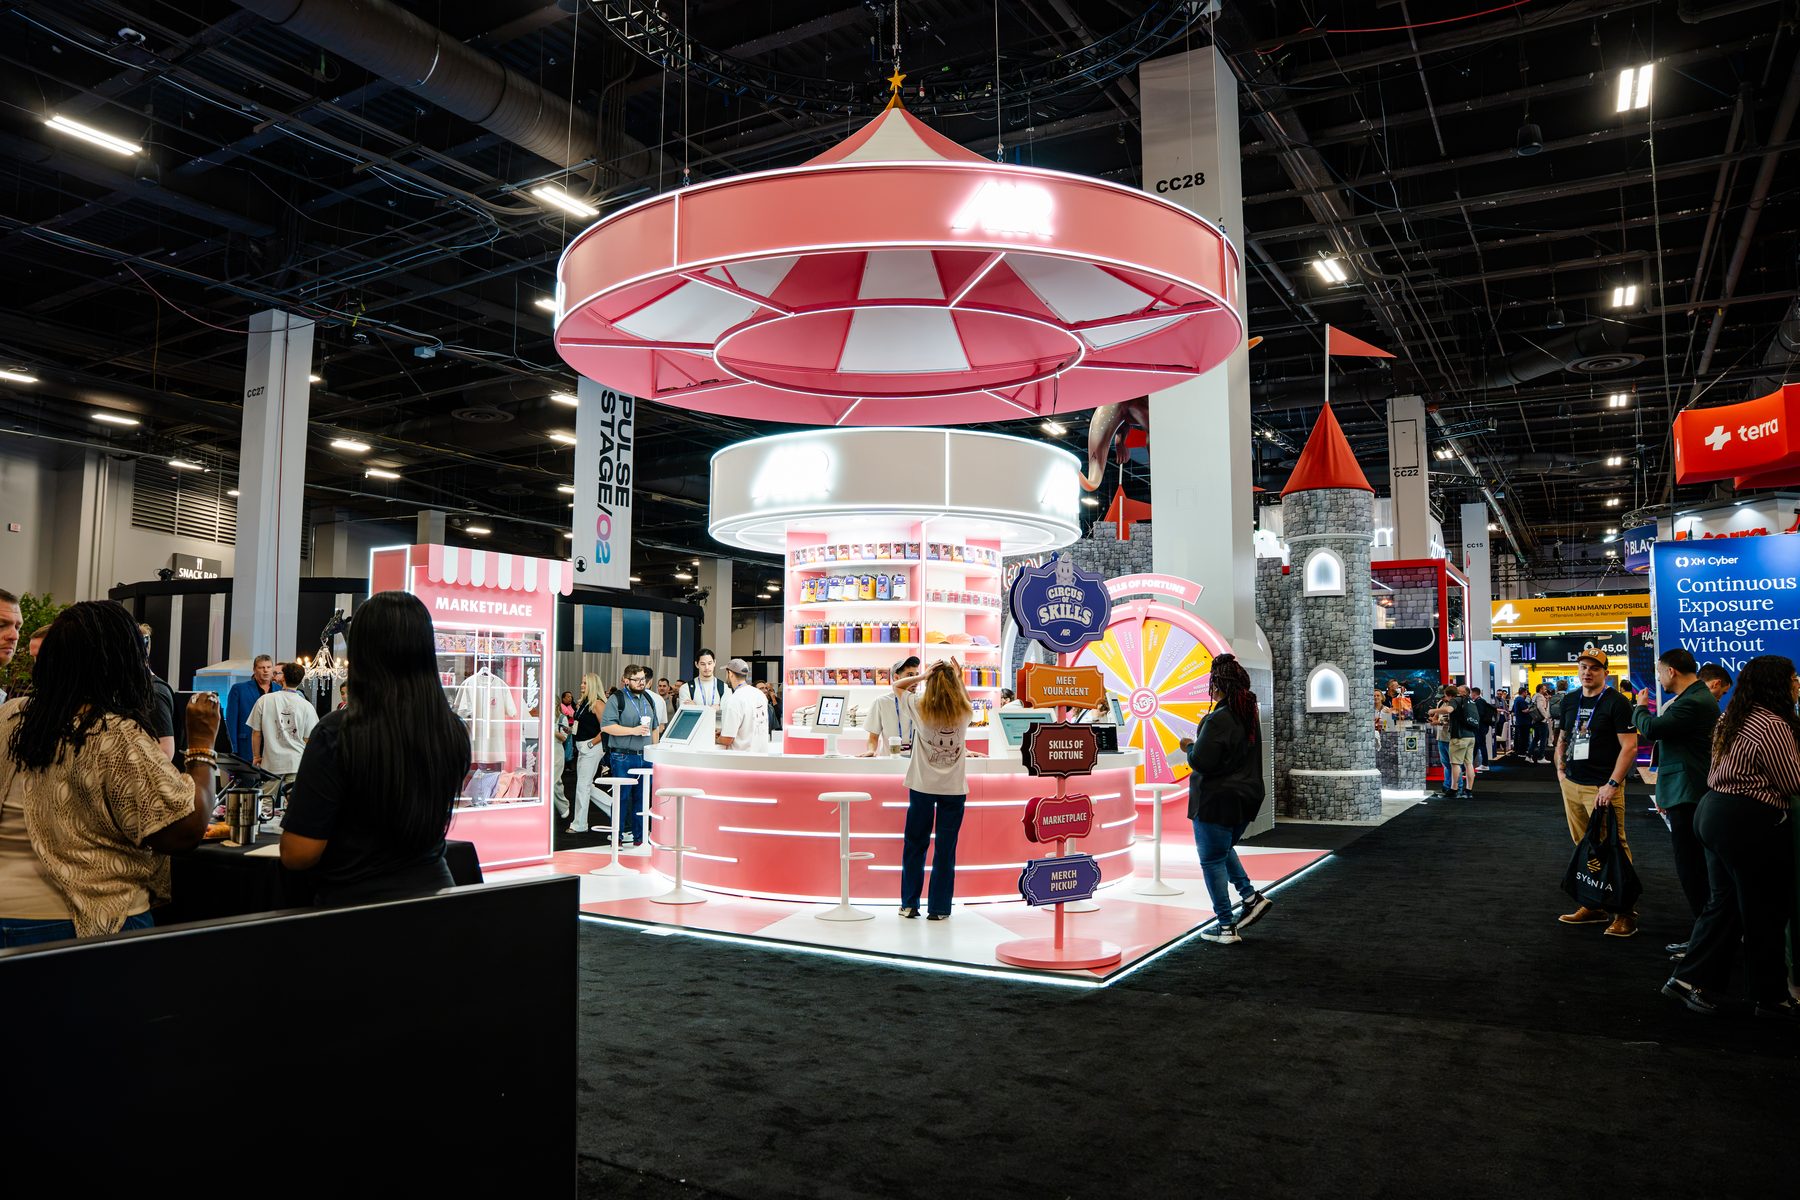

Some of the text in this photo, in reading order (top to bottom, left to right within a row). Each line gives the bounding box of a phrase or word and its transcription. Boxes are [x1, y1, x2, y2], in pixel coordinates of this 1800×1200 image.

[1156, 172, 1206, 194] CC28
[247, 386, 265, 398] CC27
[1737, 418, 1778, 442] terra
[615, 394, 633, 508] PULSE
[1394, 469, 1420, 478] CC22
[1691, 555, 1739, 567] XM Cyber
[179, 567, 203, 580] SNACK
[1128, 580, 1140, 588] OF
[1141, 579, 1186, 594] FORTUNE
[1677, 576, 1797, 593] Continuous
[1048, 586, 1083, 600] CIRCUS
[435, 597, 533, 617] MARKETPLACE
[1038, 603, 1092, 625] SKILLS
[1678, 598, 1774, 617] Exposure
[1680, 636, 1765, 652] Without
[1056, 676, 1077, 685] MEET
[1043, 686, 1089, 696] YOUR AGENT
[1049, 740, 1084, 749] SKILLS OF
[1049, 751, 1083, 760] FORTUNE
[1043, 812, 1087, 826] MARKETPLACE
[1051, 869, 1077, 881] MERCH
[1576, 871, 1613, 892] SYGNIA
[1050, 880, 1078, 892] PICKUP
